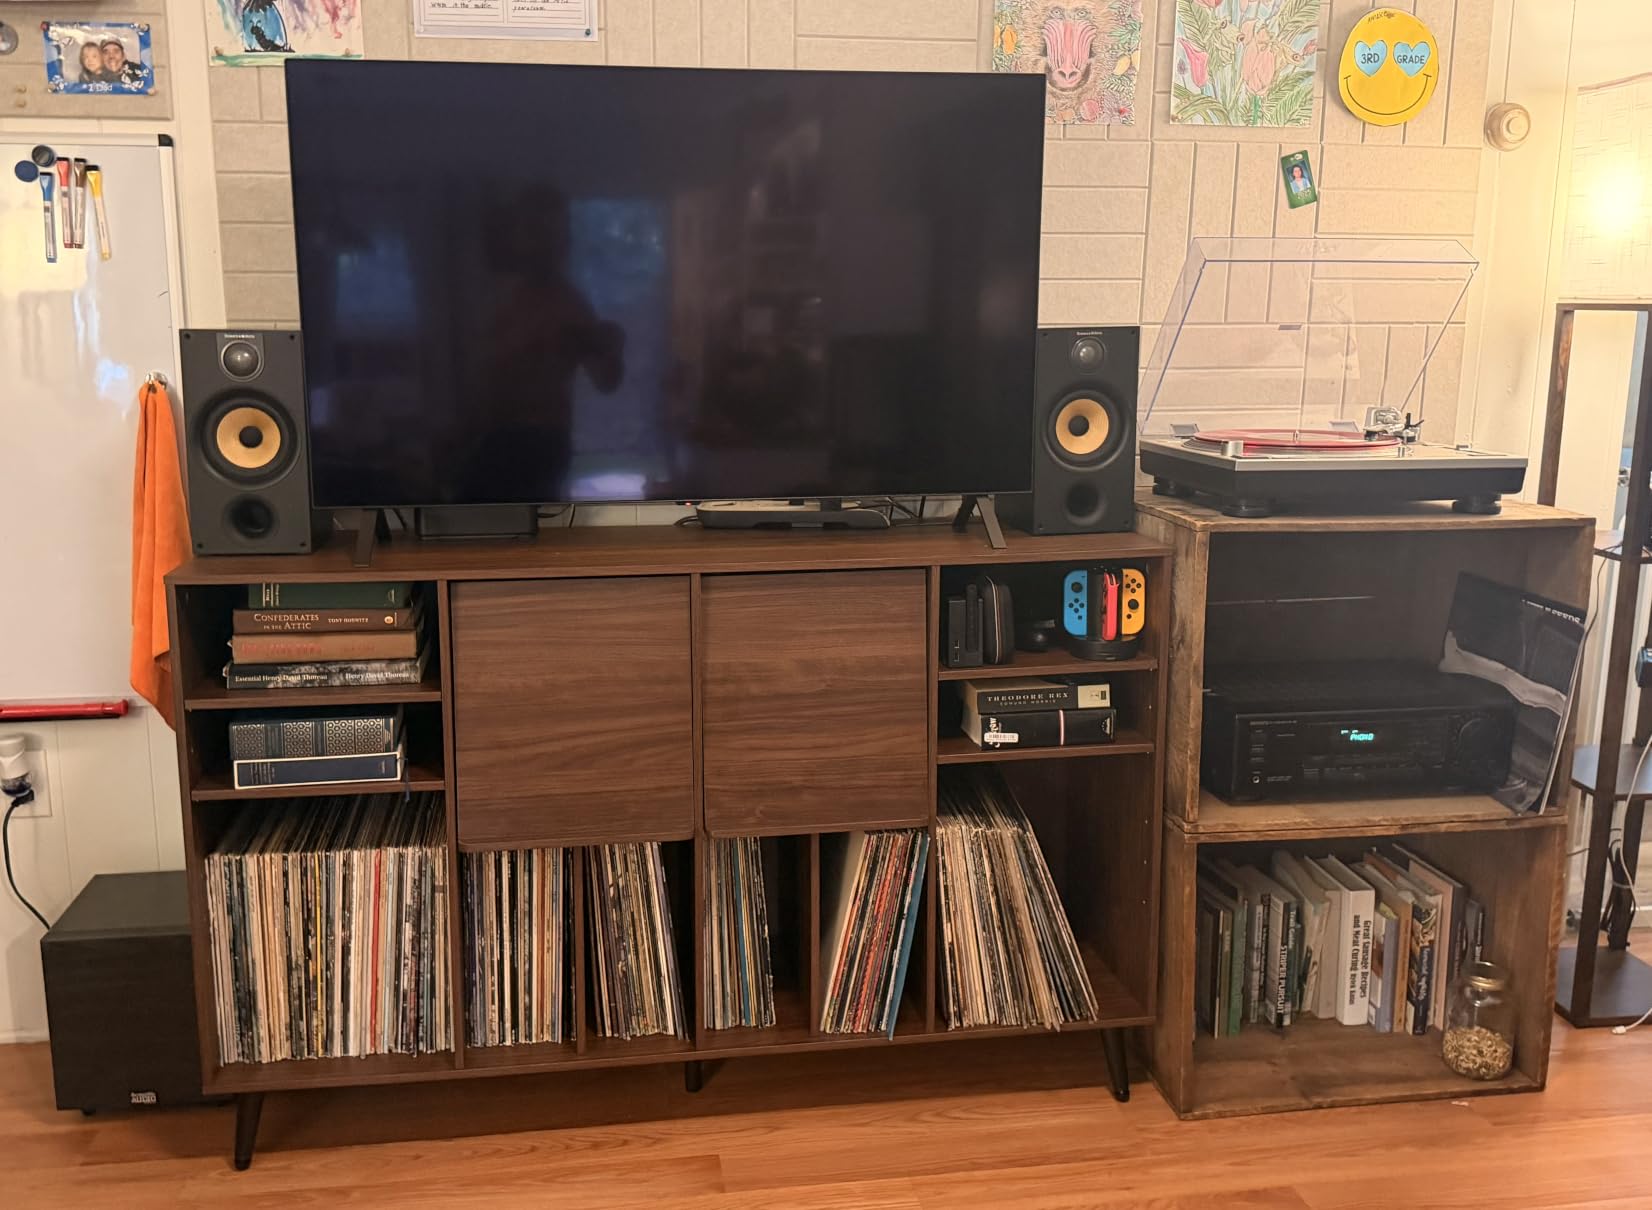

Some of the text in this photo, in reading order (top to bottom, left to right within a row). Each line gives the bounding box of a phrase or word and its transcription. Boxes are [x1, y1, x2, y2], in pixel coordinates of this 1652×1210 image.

[1361, 53, 1380, 64] 3RD
[1396, 54, 1425, 65] GRADE
[254, 613, 320, 622] CONFEDERATES
[284, 621, 312, 630] ATTIC
[986, 693, 1043, 702] THEODORE
[1352, 930, 1361, 947] Meat
[1350, 948, 1360, 972] Curing
[1360, 920, 1372, 999] Great Sausage Recipes
